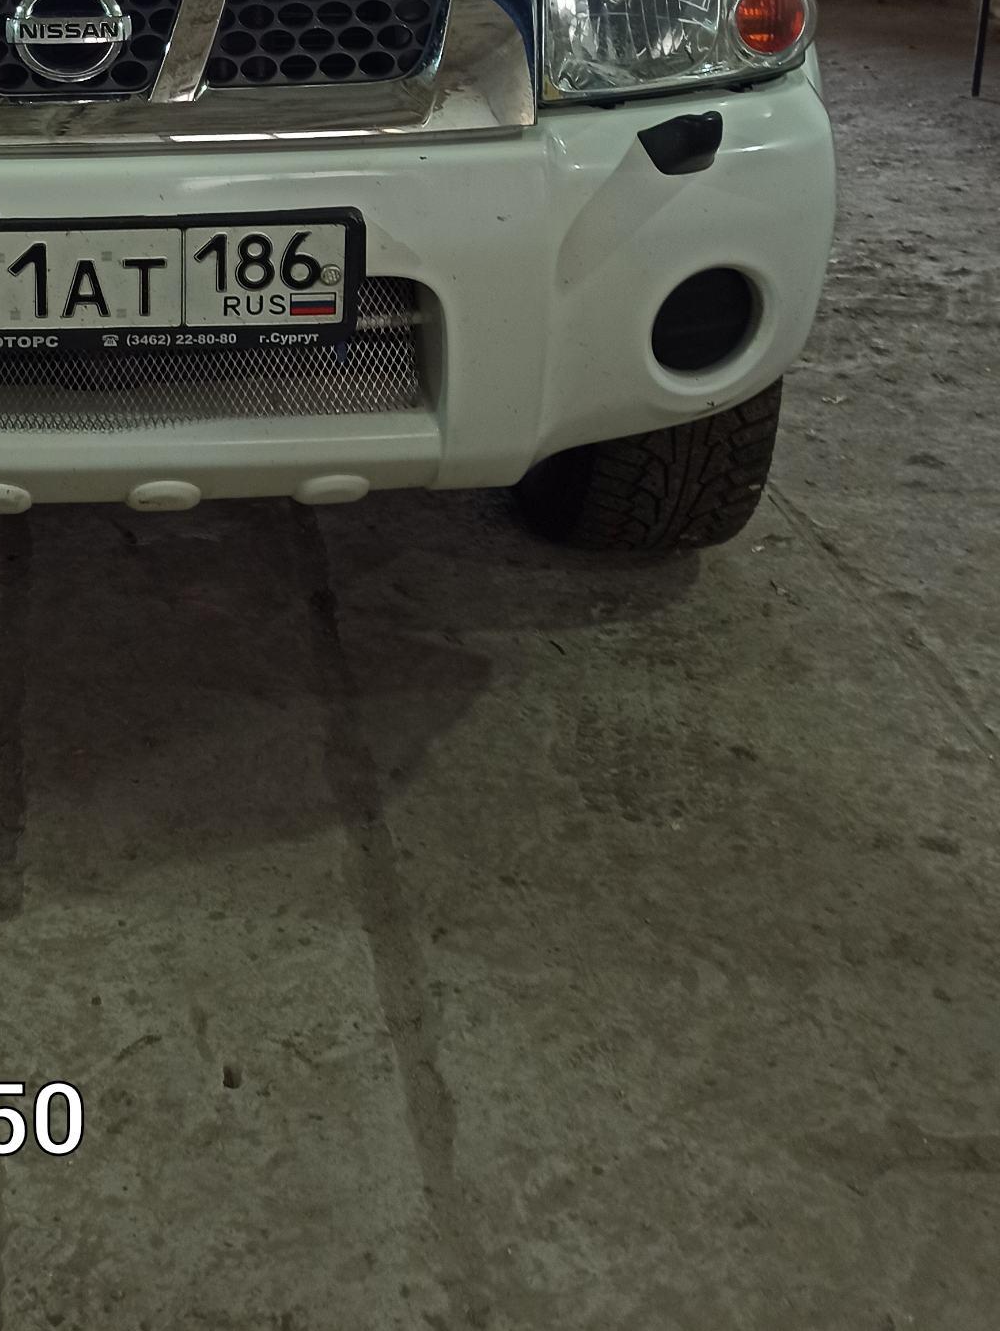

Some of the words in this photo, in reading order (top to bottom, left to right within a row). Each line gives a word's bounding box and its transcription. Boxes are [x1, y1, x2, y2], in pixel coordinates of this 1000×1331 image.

[20, 22, 118, 39] NISSAN
[192, 231, 322, 293] 186
[222, 294, 288, 317] RUS
[125, 332, 171, 347] (3462)
[175, 332, 237, 346] 22-80-80
